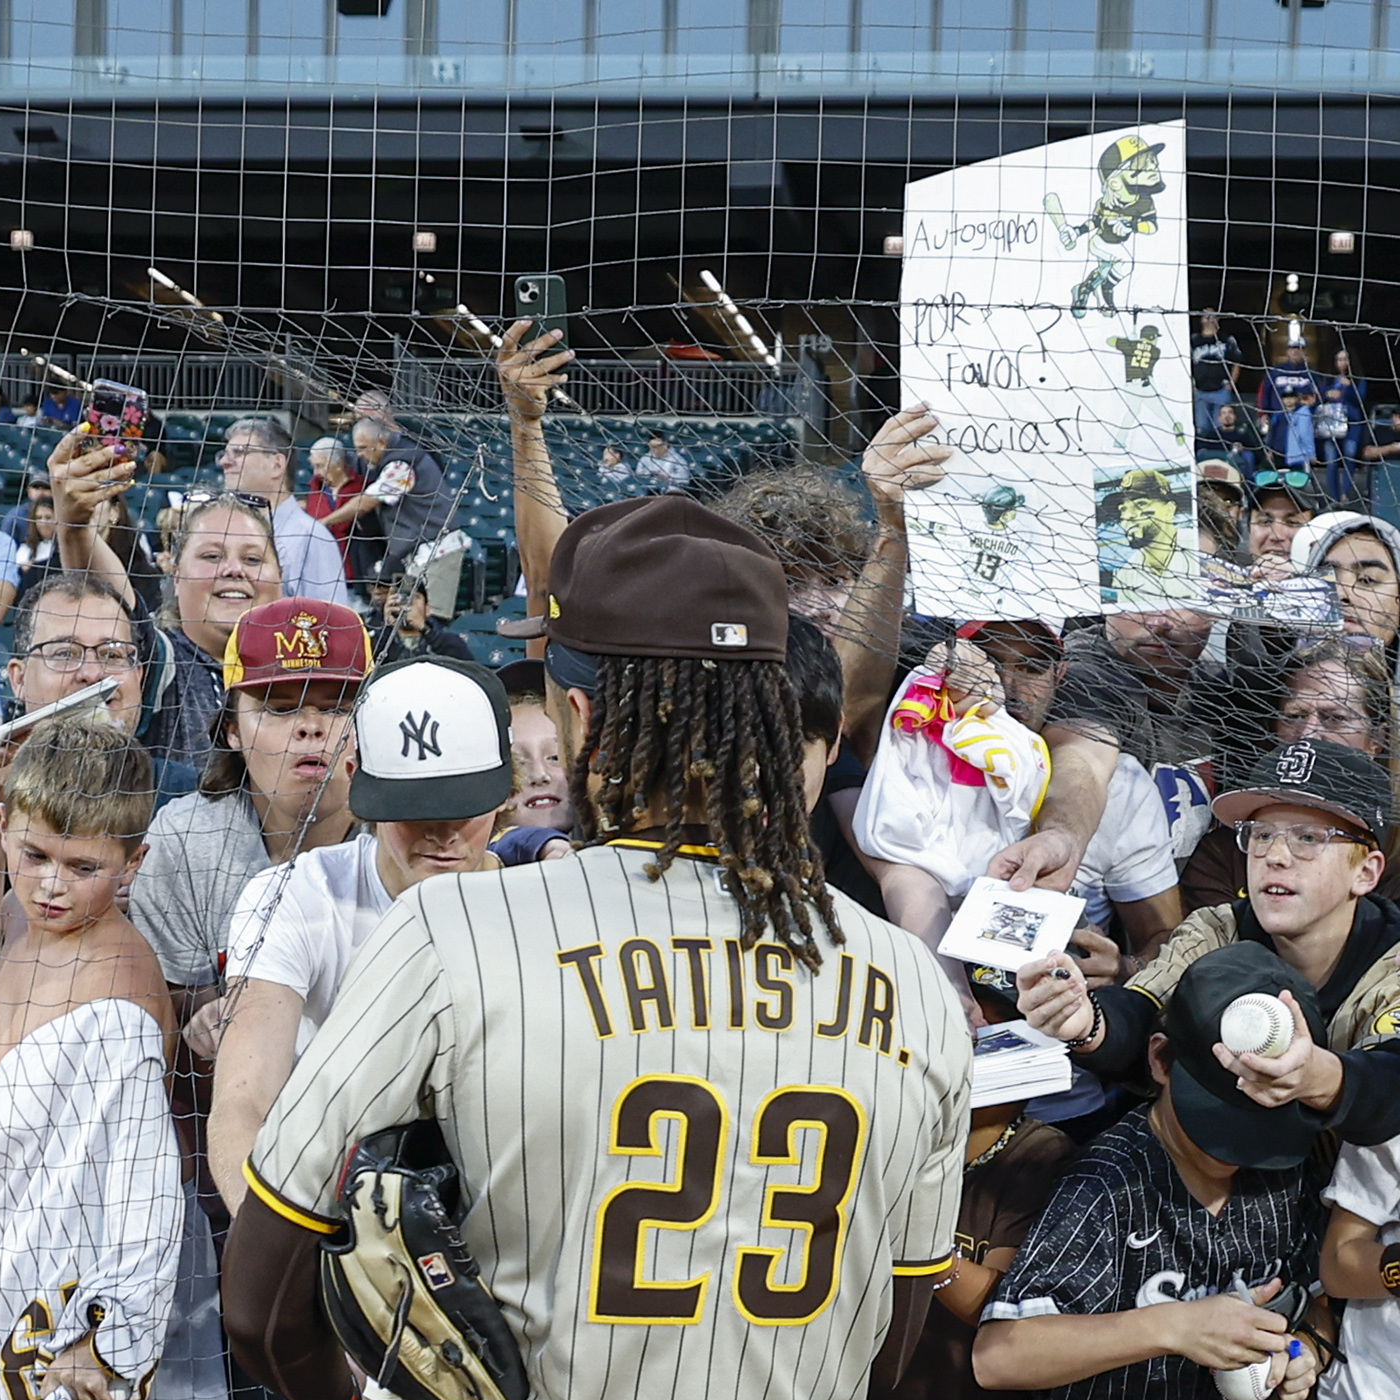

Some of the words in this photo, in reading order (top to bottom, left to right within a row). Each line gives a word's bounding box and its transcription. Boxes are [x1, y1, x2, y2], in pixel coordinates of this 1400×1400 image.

[914, 292, 971, 346] POR
[1130, 349, 1152, 368] 22
[973, 551, 1002, 582] 13
[281, 658, 322, 668] MINNESOTA
[399, 710, 443, 761] NY
[556, 936, 796, 1041] TATIS
[814, 950, 912, 1068] JR.
[586, 1073, 867, 1327] 23
